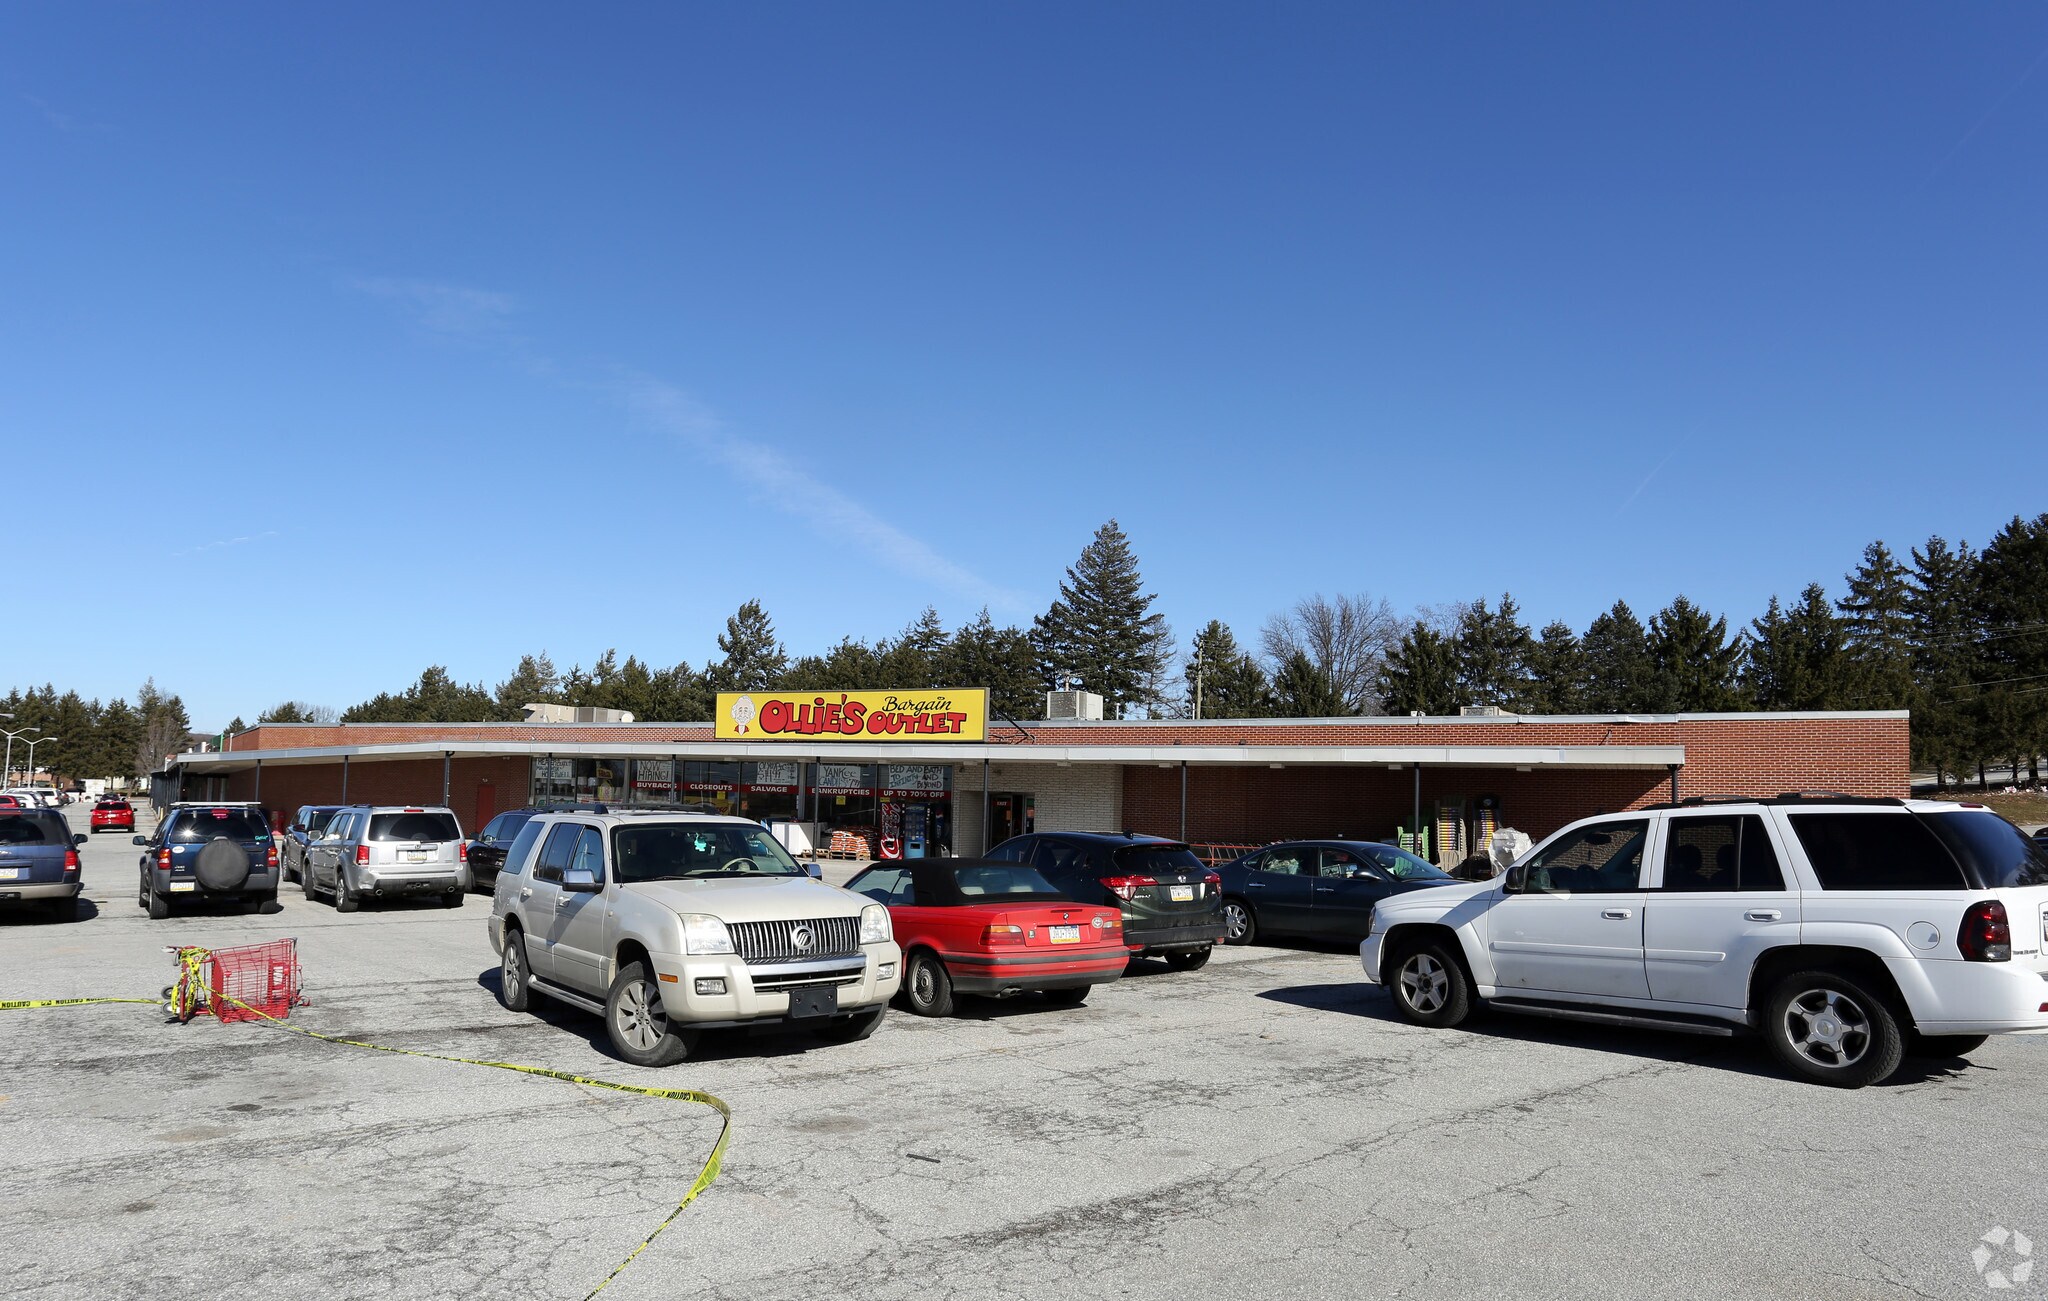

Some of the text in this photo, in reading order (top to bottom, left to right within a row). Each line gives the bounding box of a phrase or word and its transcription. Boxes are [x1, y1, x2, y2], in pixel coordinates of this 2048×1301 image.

[881, 695, 952, 716] Bargain
[867, 711, 967, 734] OUTLET
[640, 760, 660, 771] NOW
[890, 765, 943, 775] BED AND BATH
[638, 770, 669, 781] HIRING!
[890, 773, 901, 782] TO
[921, 773, 939, 781] AND
[689, 783, 733, 791] CLOSEOUTS
[910, 790, 928, 798] 70%
[1, 1000, 31, 1008] CAUTION
[666, 1091, 691, 1101] CAUTION
